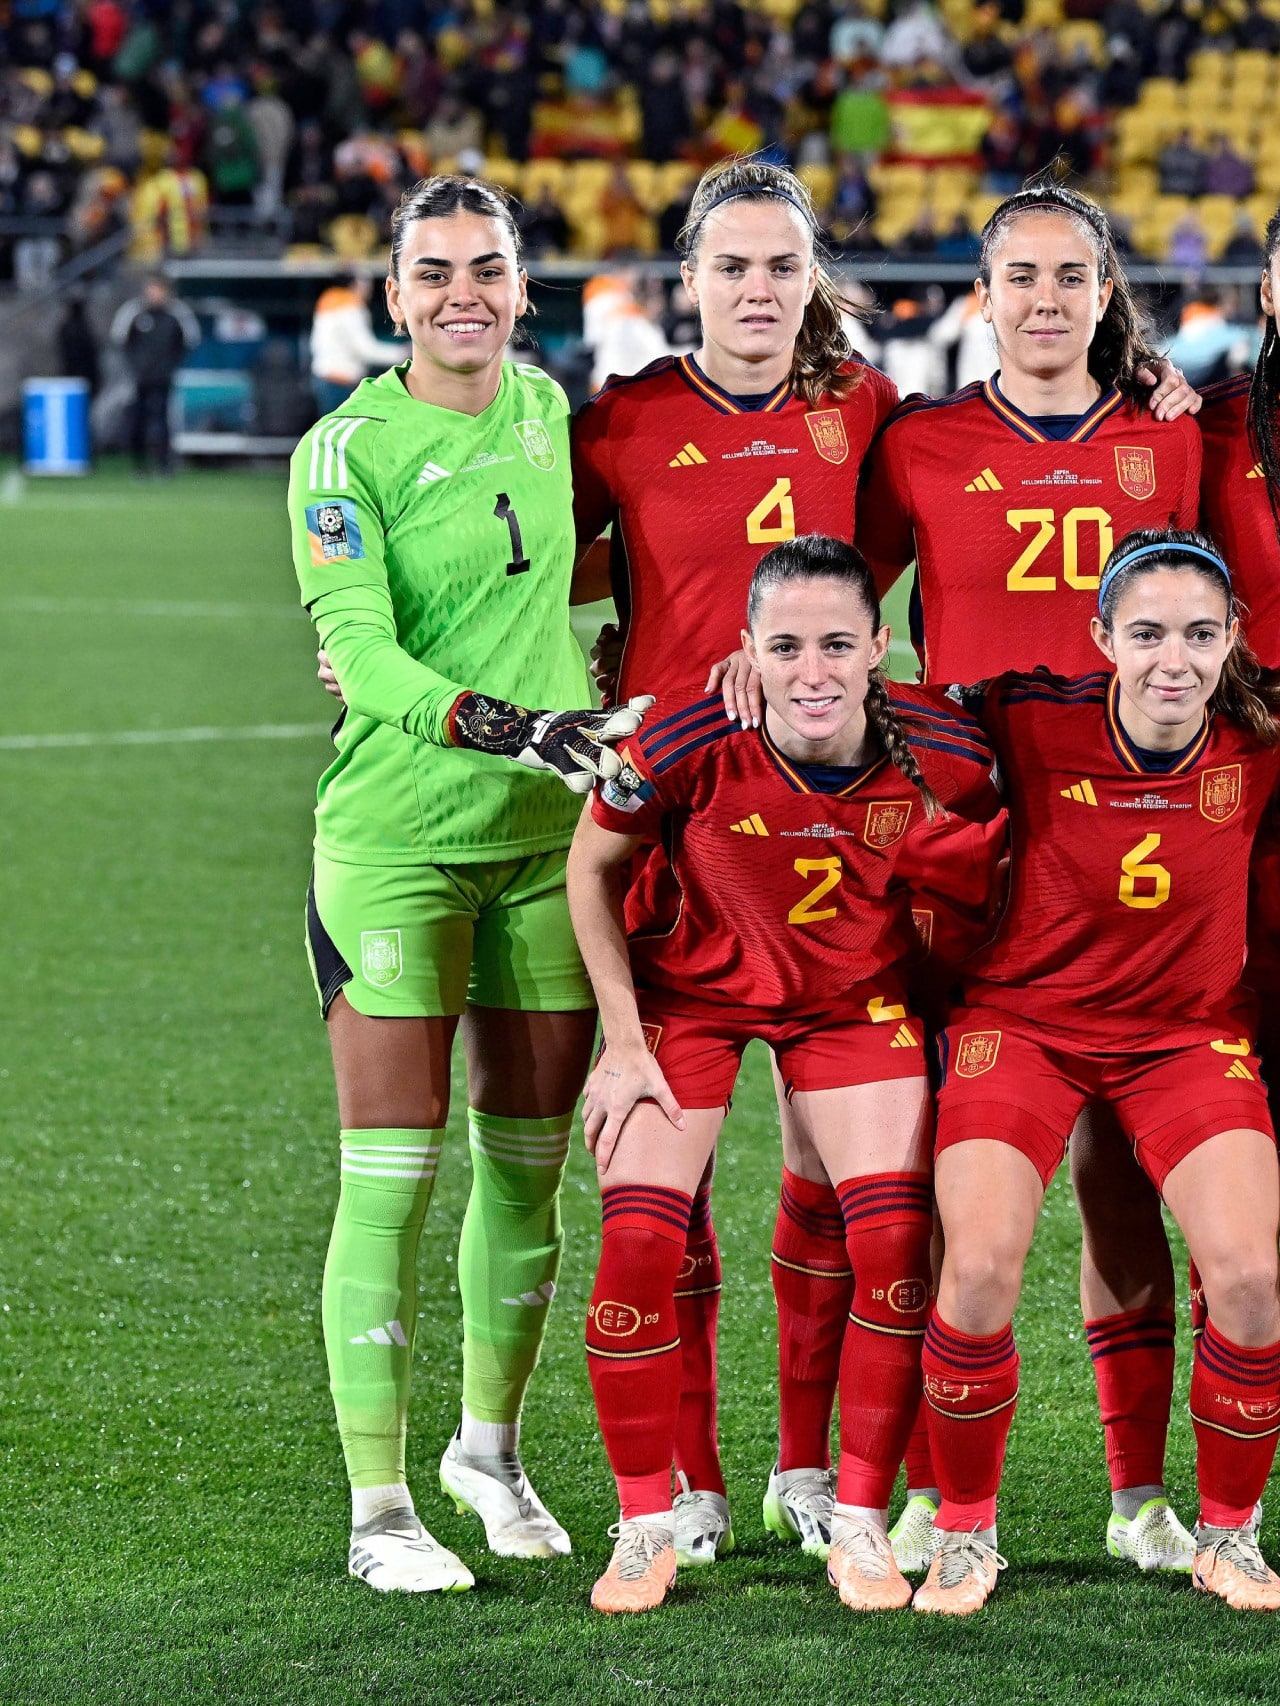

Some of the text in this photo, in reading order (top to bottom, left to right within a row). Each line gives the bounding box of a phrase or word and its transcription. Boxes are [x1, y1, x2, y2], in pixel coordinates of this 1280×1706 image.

[494, 493, 531, 576] 1
[746, 478, 795, 544] 4
[1006, 506, 1113, 591] 20
[788, 856, 842, 925] 2
[1119, 833, 1171, 909] 6
[644, 1313, 660, 1325] 09
[871, 1288, 885, 1300] 19
